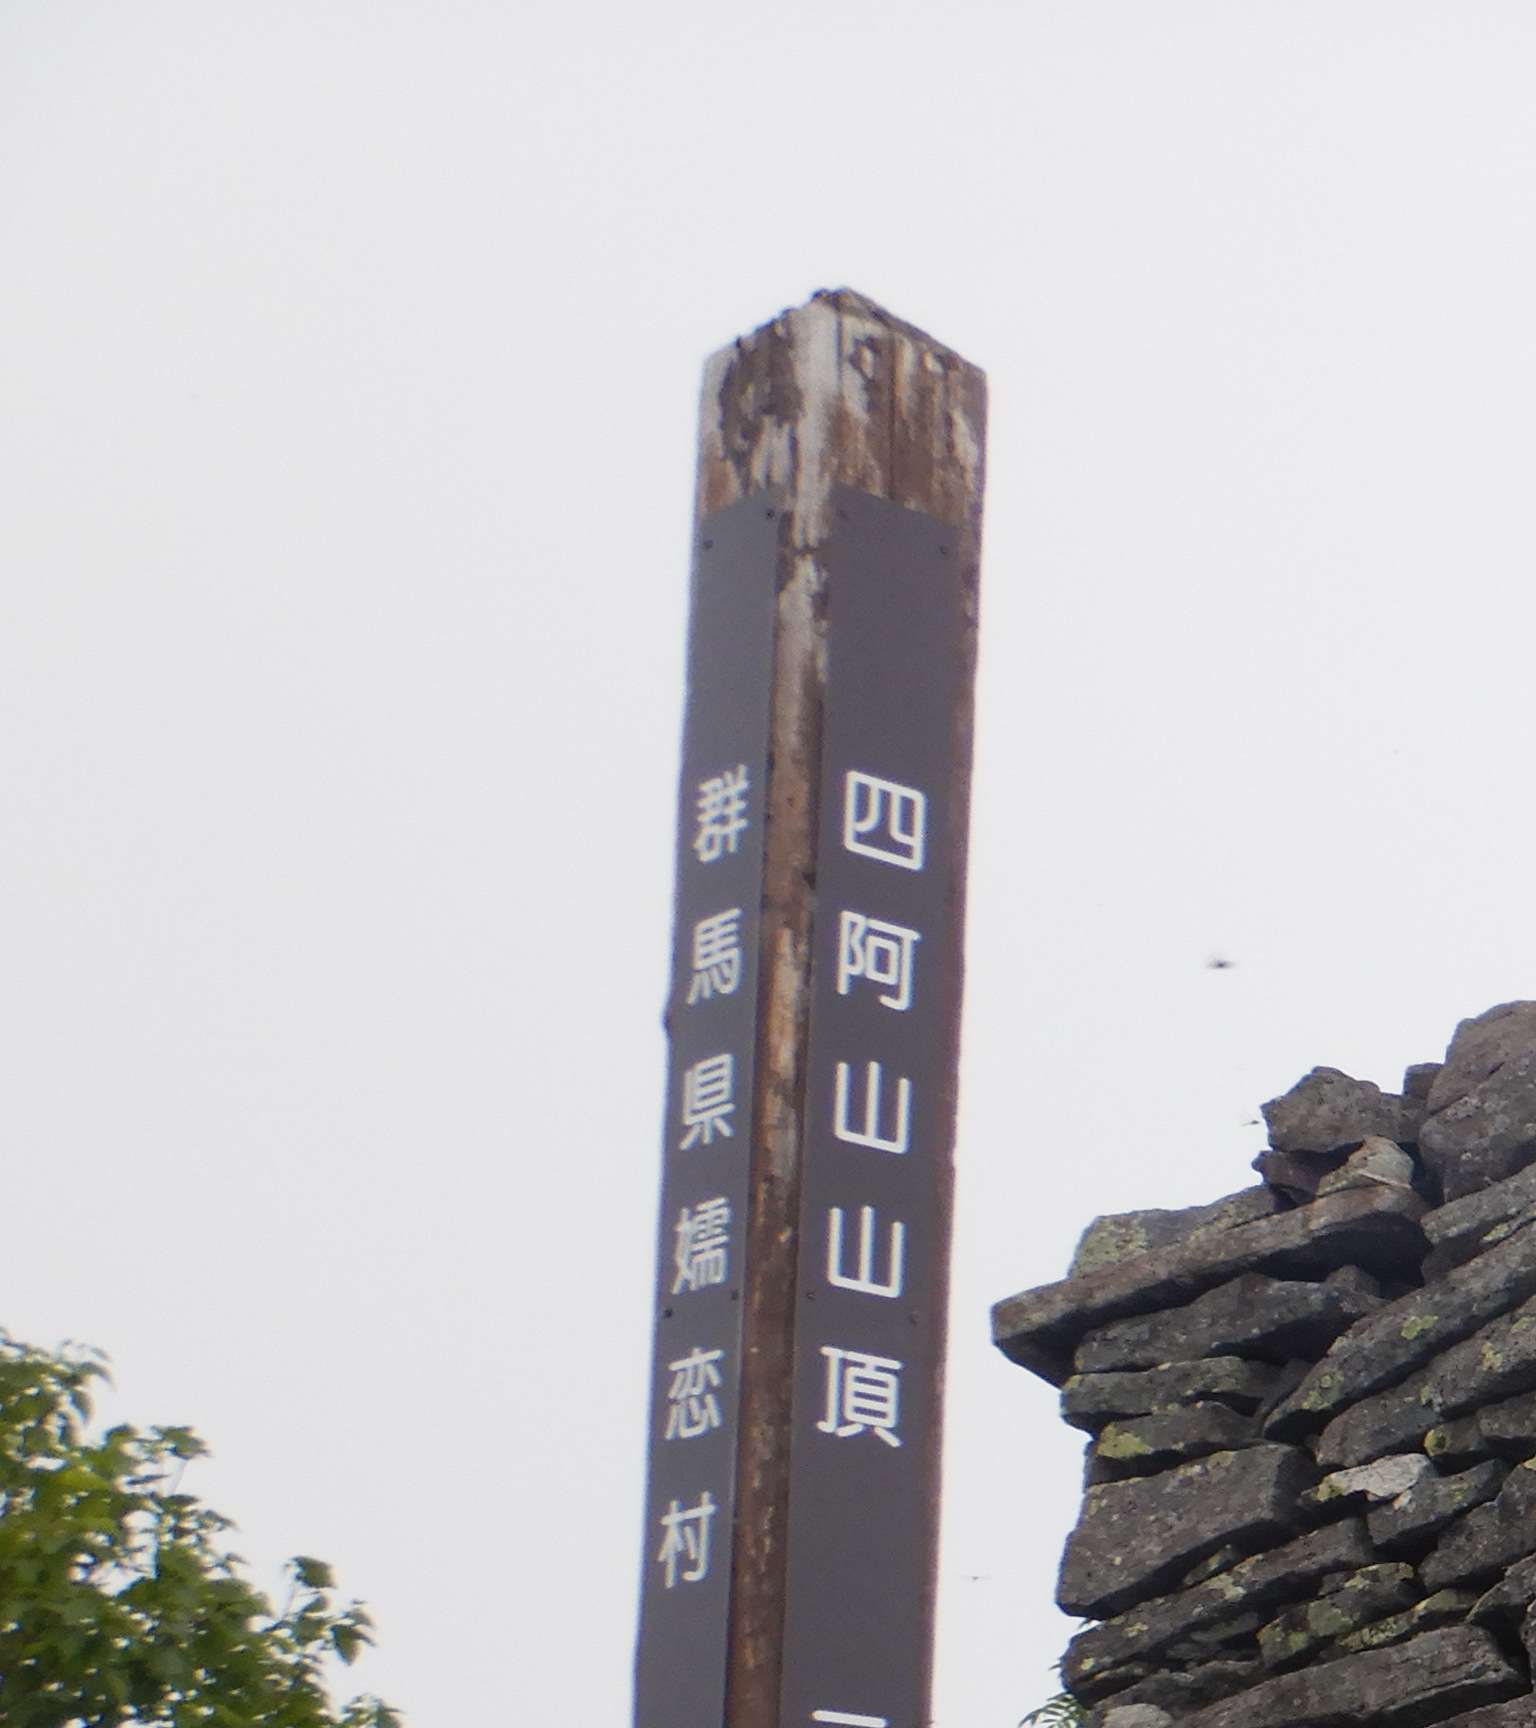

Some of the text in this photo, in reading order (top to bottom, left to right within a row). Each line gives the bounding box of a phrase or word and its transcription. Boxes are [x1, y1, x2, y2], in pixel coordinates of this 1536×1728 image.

[656, 764, 749, 1590] 群馬県嬬恋村
[816, 769, 926, 1449] 四阿山山頂
